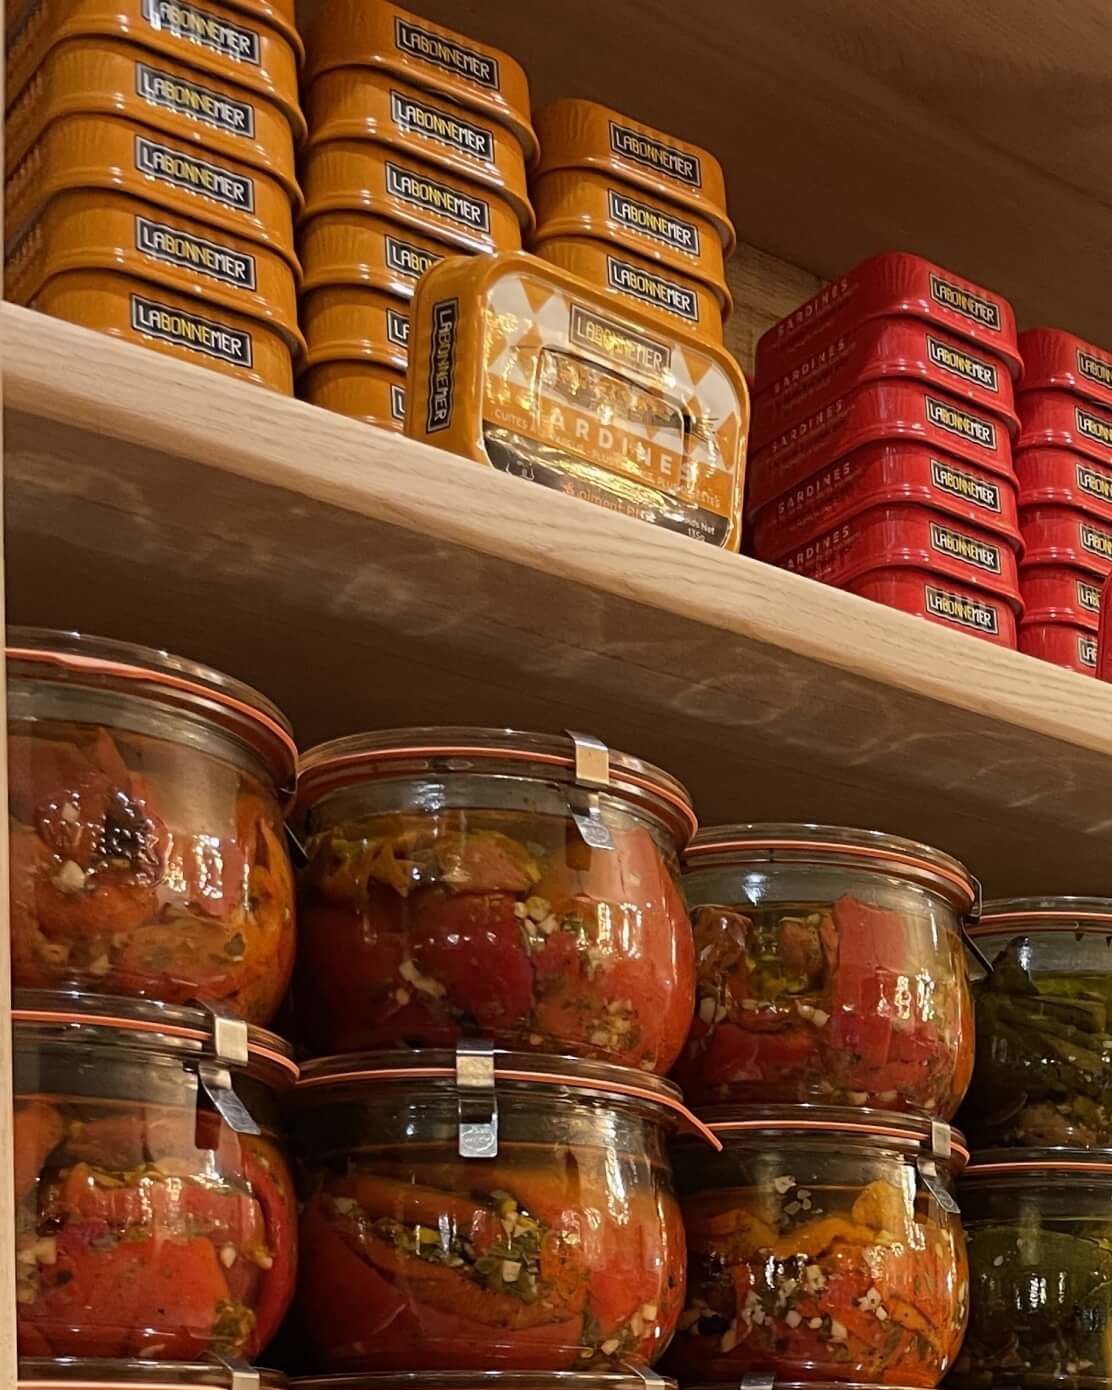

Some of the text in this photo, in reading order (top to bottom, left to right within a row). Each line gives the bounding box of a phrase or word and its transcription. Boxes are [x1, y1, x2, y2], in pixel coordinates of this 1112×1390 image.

[401, 26, 490, 80] LABONNEMER
[143, 71, 244, 128] LABONNEMER
[399, 100, 485, 152] LABONNEMER
[143, 146, 244, 202] LABONNEMER
[615, 131, 693, 175] LABONNEMER
[392, 171, 481, 223] LABONNEMER
[615, 200, 691, 246] LABONNEMER
[142, 227, 246, 279] LABONNEMER
[614, 267, 690, 312] LABONNEMER
[934, 281, 994, 322] LABONNEMER
[138, 304, 242, 357] LABONNEMER
[432, 309, 454, 421] LABONNEMER
[931, 343, 991, 384] LABONNEMER
[530, 402, 699, 490] ARDINES
[929, 403, 990, 442] LABONNEMER
[778, 462, 850, 514] SARDINES
[934, 466, 994, 506] LABONNEMER
[934, 529, 994, 565] LABONNEMER
[929, 592, 991, 626] LABONNEMER
